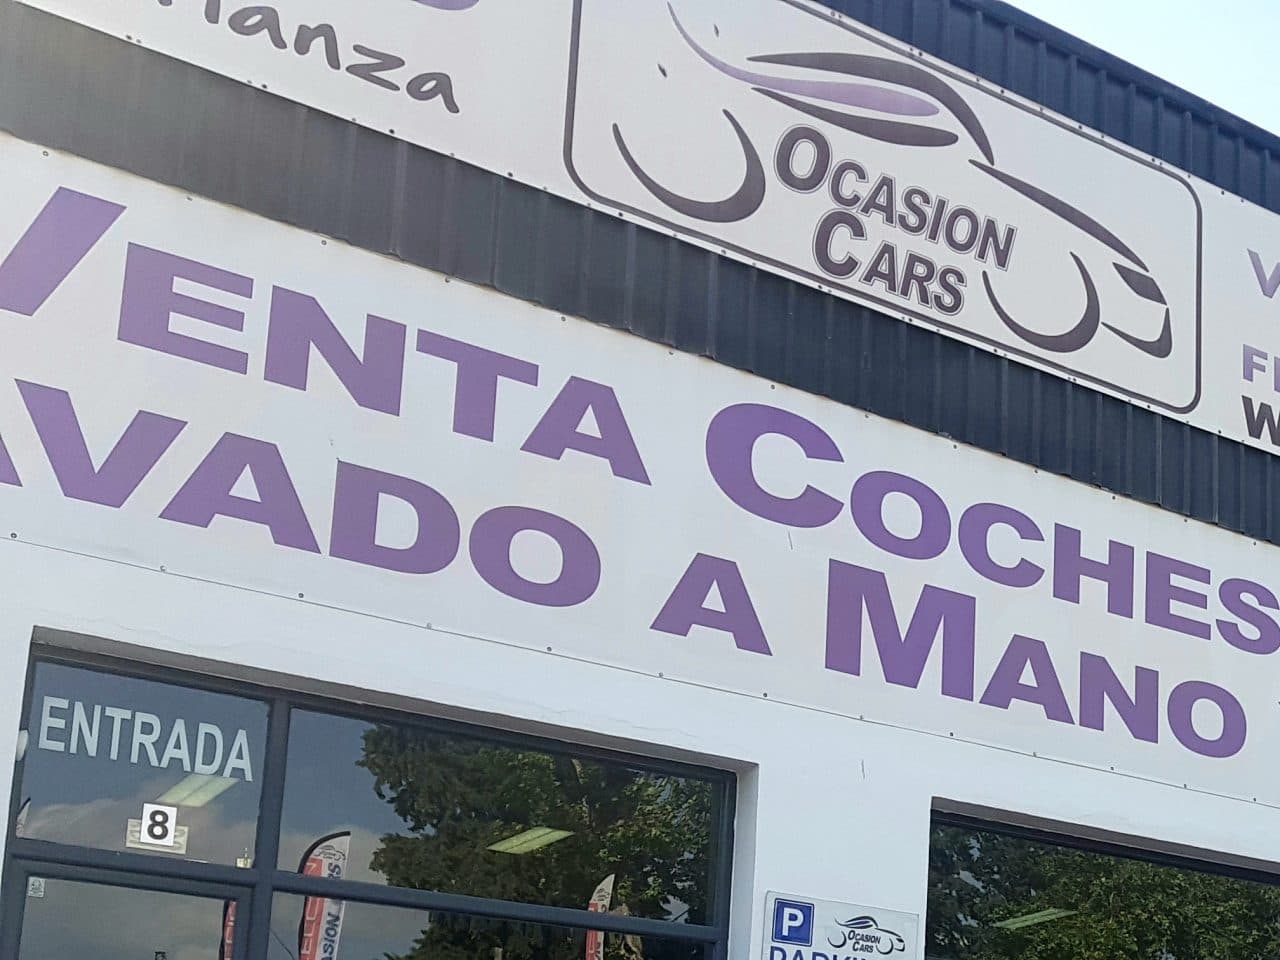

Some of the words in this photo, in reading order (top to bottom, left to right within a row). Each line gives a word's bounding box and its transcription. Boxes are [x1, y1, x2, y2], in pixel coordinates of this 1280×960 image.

[650, 553, 773, 656] A
[824, 559, 1248, 758] MANO
[38, 696, 253, 781] ENTRADA
[146, 810, 170, 840] 8
